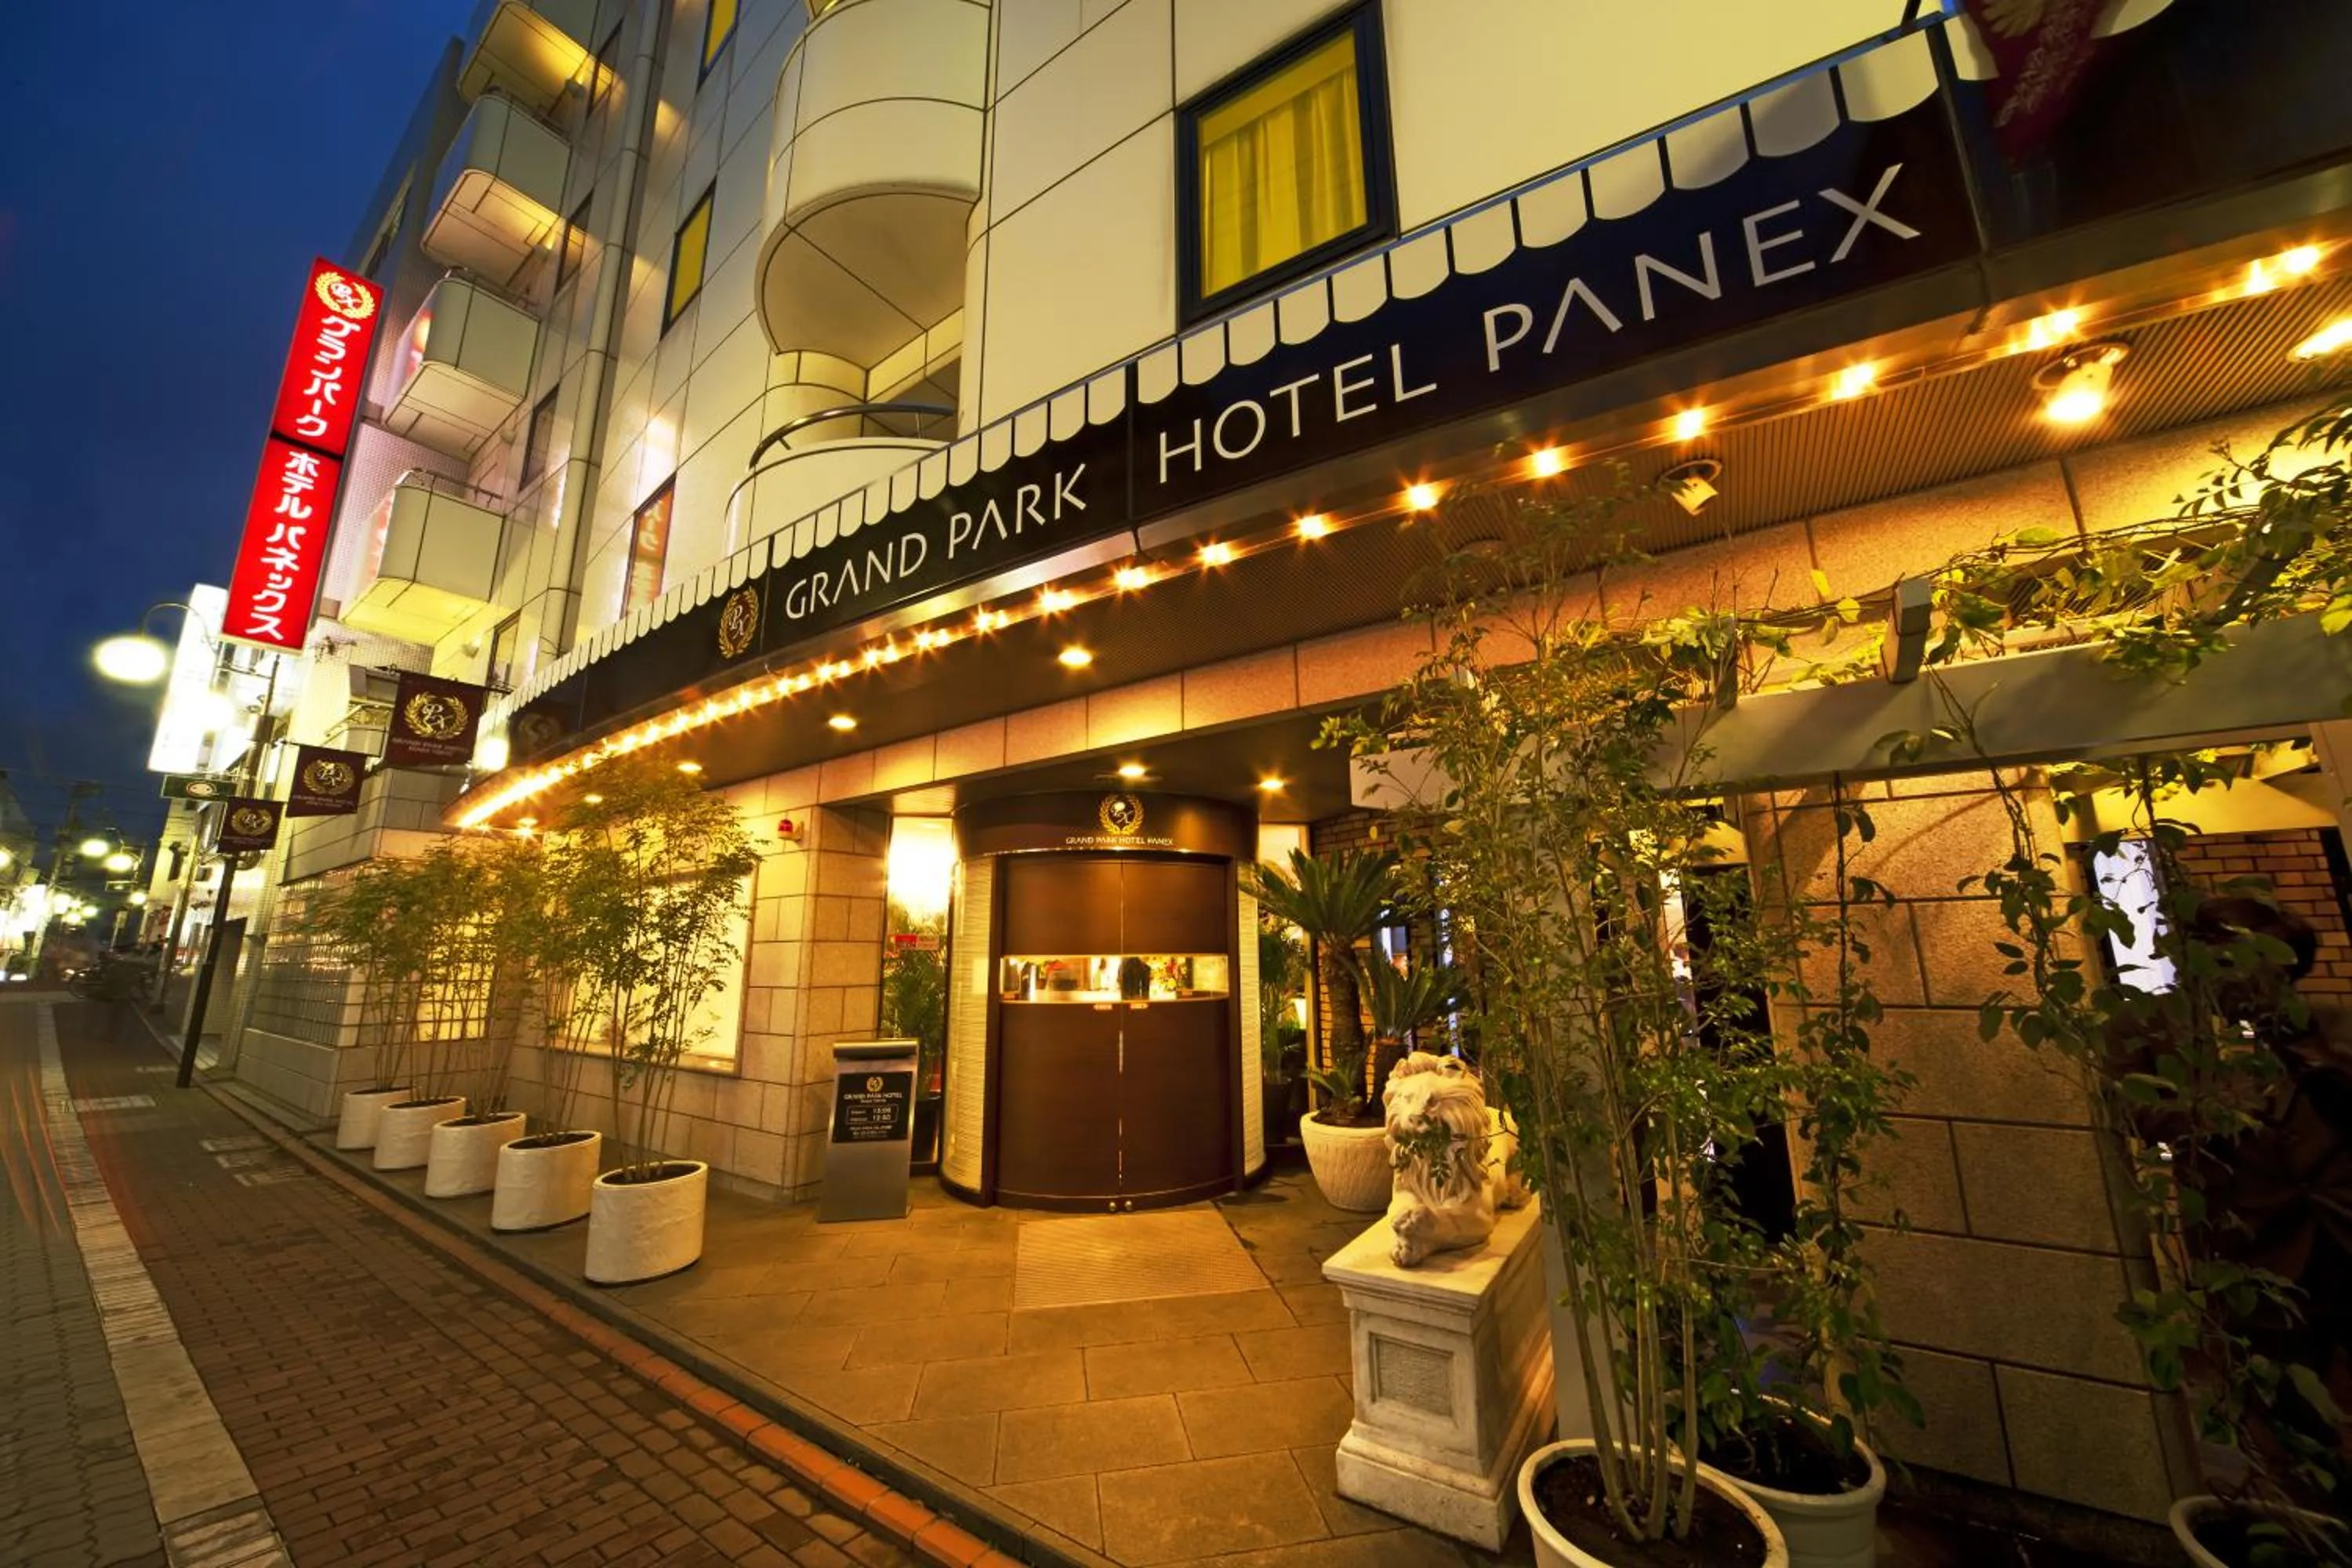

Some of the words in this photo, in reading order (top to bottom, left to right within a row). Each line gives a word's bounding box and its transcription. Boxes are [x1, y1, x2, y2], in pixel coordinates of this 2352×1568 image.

[786, 532, 928, 620] GRAND
[948, 463, 1087, 560] PARK
[1159, 343, 1438, 485] HOTEL
[1483, 162, 1921, 373] PANEX
[1065, 837, 1094, 845] GRAND
[1118, 837, 1146, 845] HOTEL
